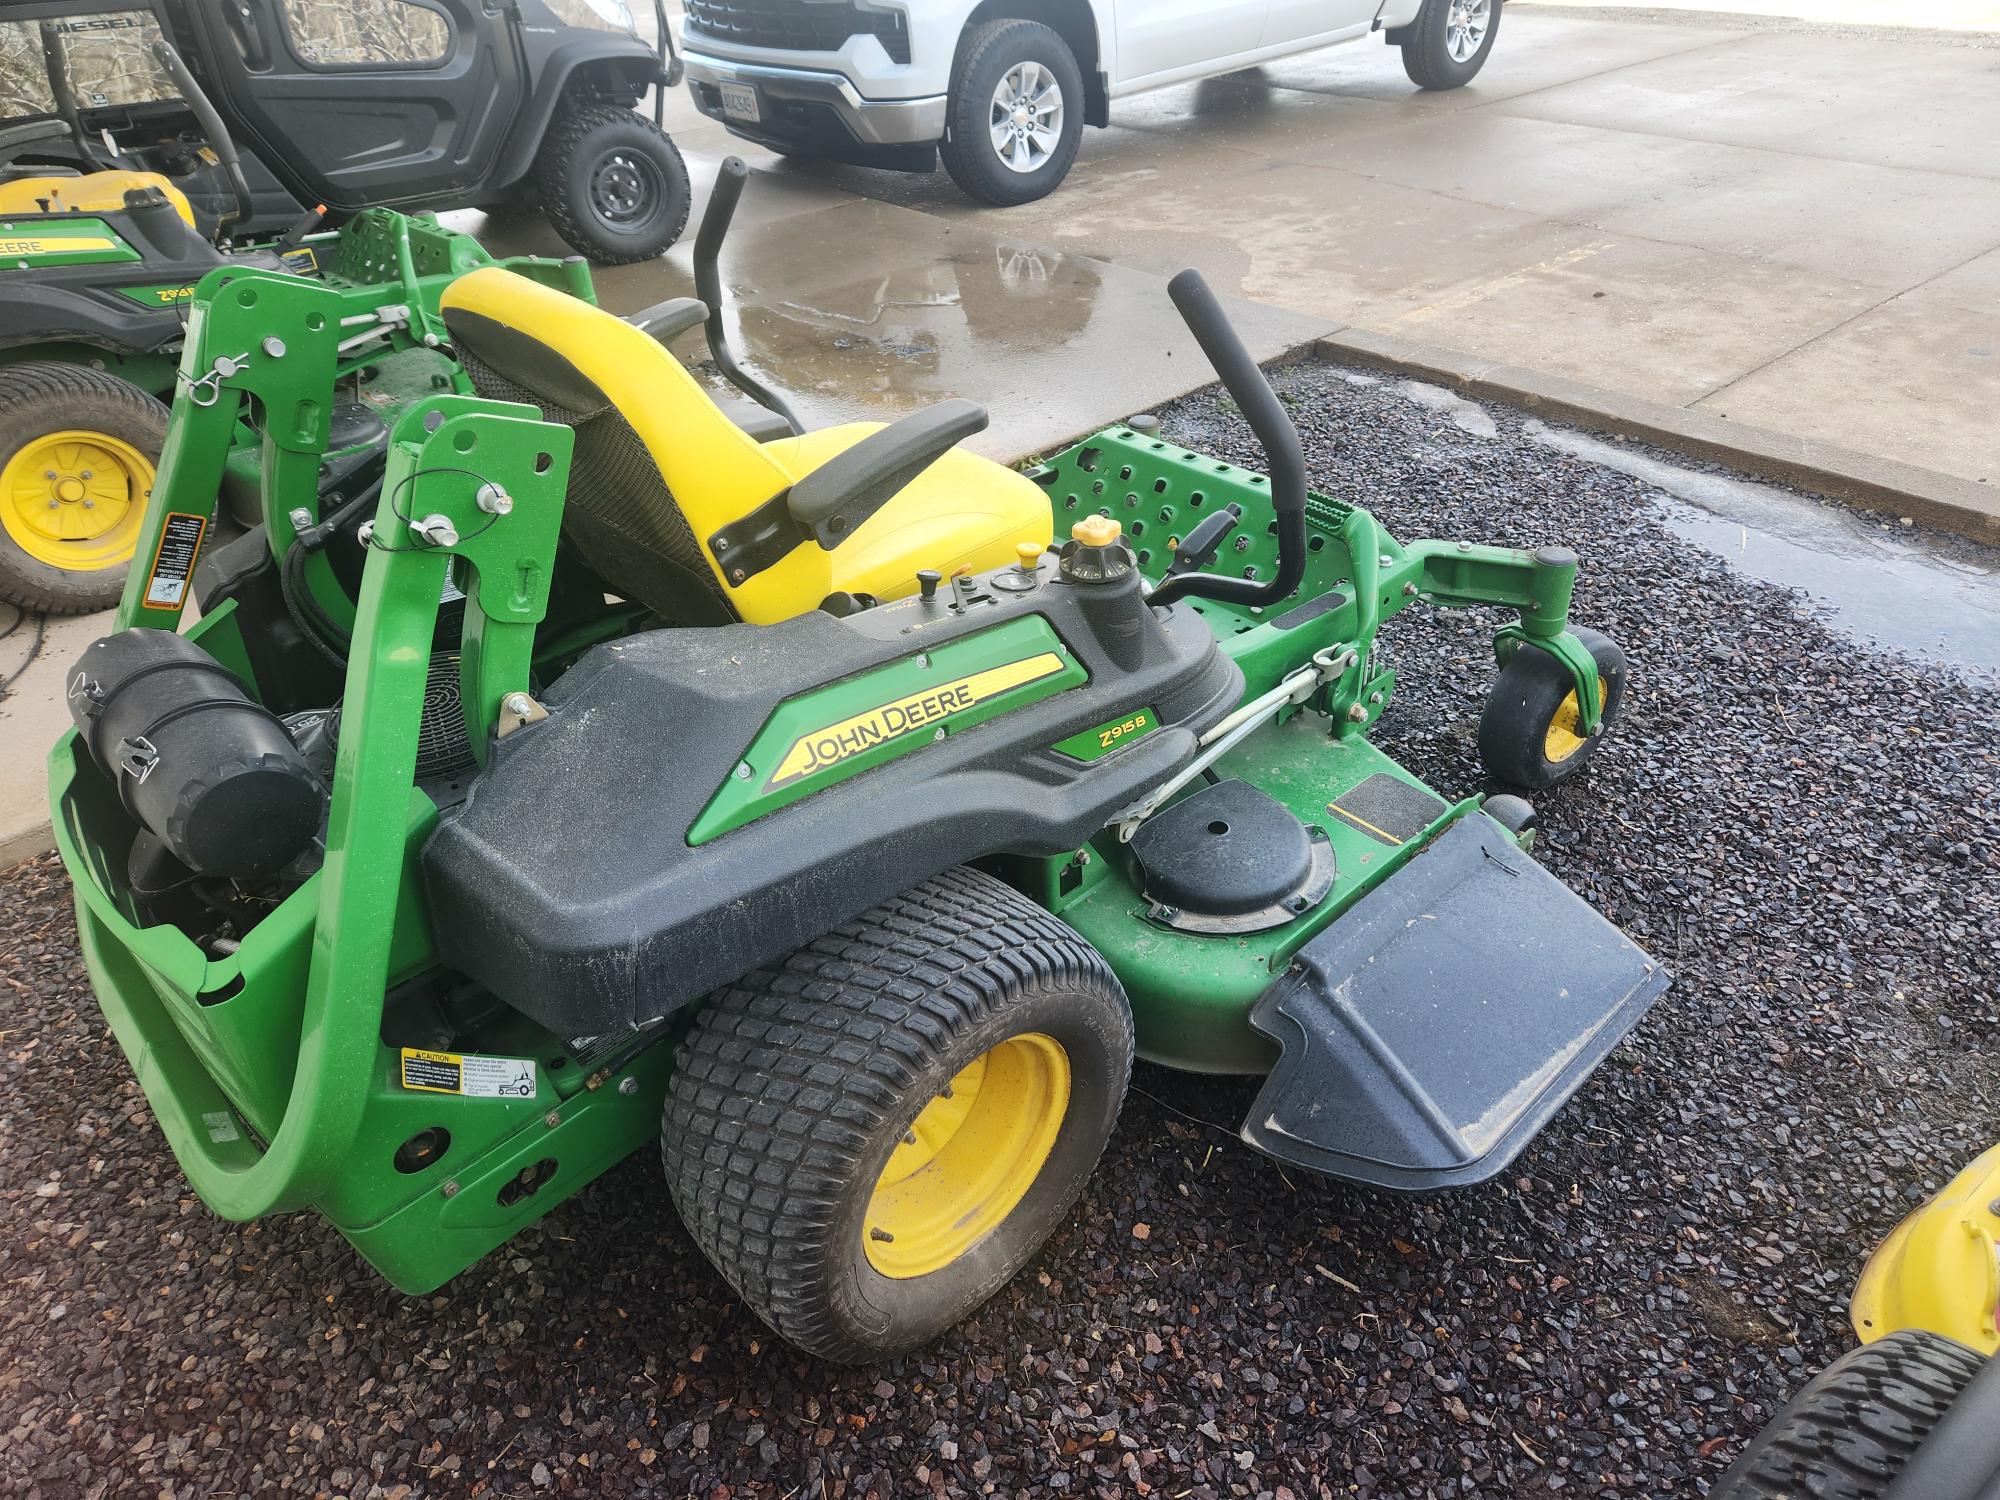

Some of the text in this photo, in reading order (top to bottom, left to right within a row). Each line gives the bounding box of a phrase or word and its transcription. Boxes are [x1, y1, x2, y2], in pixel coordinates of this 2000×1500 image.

[56, 18, 144, 33] IESEL
[802, 684, 973, 770] JOHN DEERE
[421, 1053, 449, 1062] CAUTION
